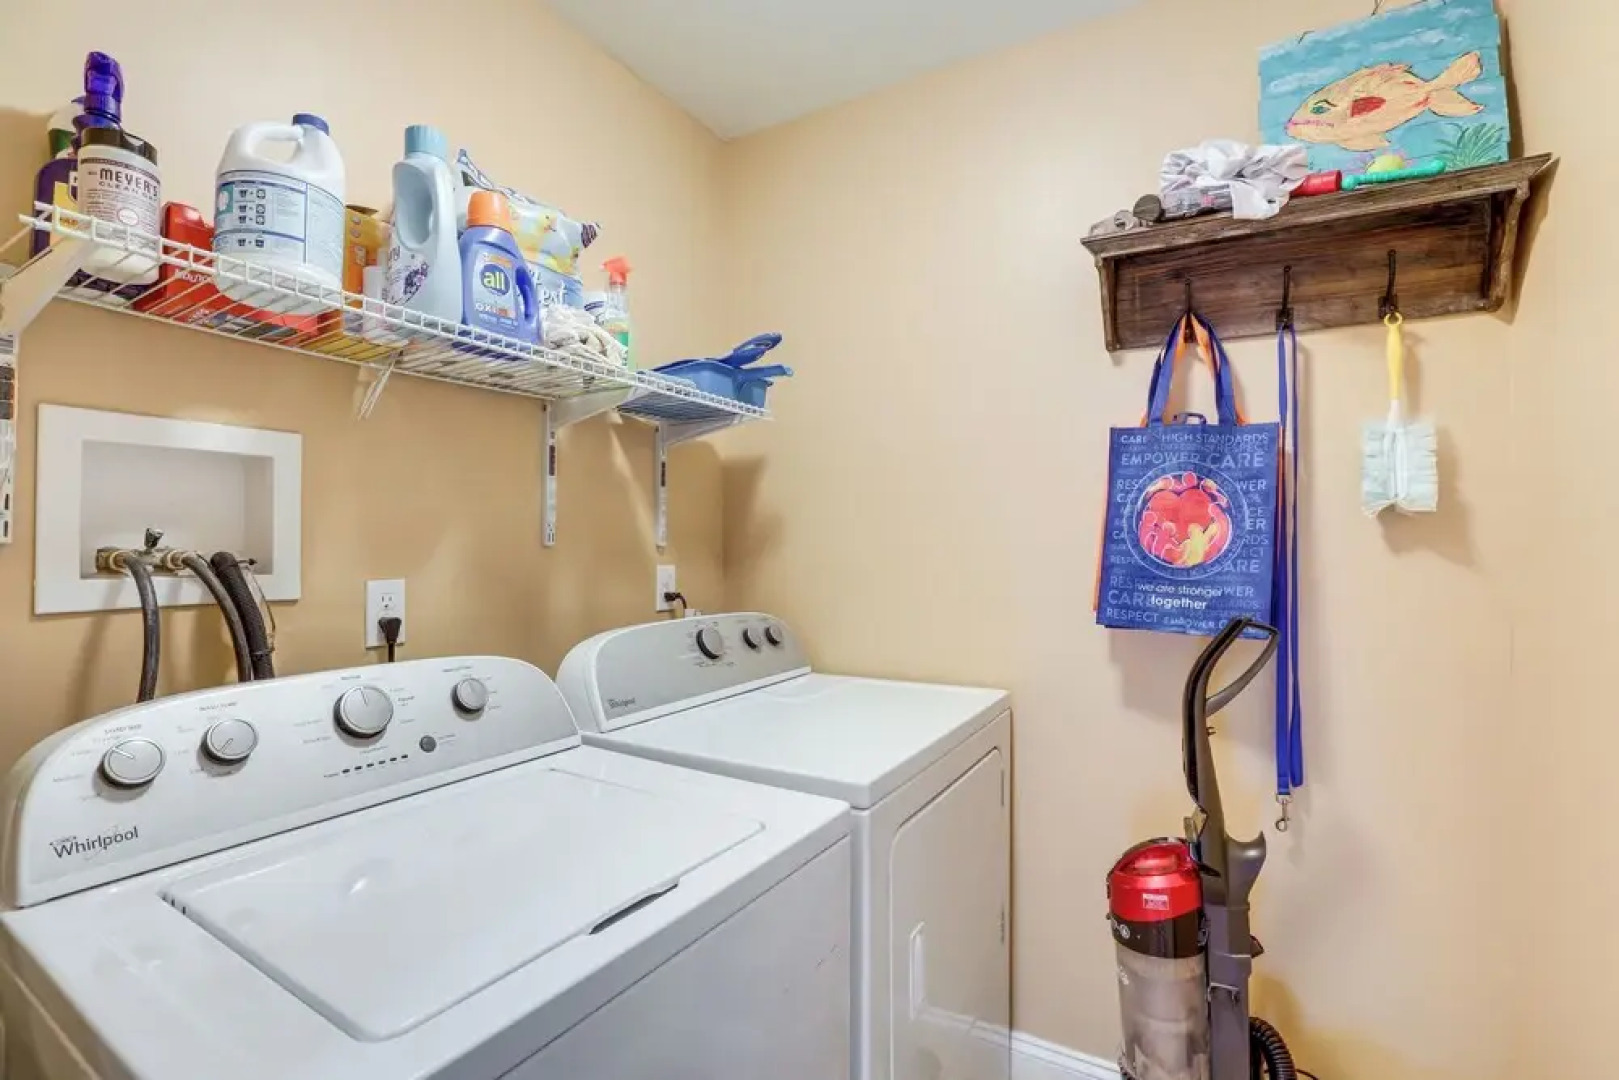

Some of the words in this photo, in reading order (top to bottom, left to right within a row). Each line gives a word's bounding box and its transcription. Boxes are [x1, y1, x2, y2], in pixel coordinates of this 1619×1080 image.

[99, 167, 159, 198] MEYER'S
[483, 270, 505, 290] all
[1161, 432, 1194, 443] HIGH
[1196, 431, 1270, 445] STANDARDS
[1120, 450, 1201, 467] EMPOWER
[1207, 450, 1266, 469] CARE
[1137, 583, 1153, 592] we
[1154, 583, 1176, 594] are
[1177, 583, 1223, 598] stronger
[1150, 595, 1208, 611] together
[1105, 607, 1160, 624] RESPECT
[49, 825, 139, 859] Whirlpool
